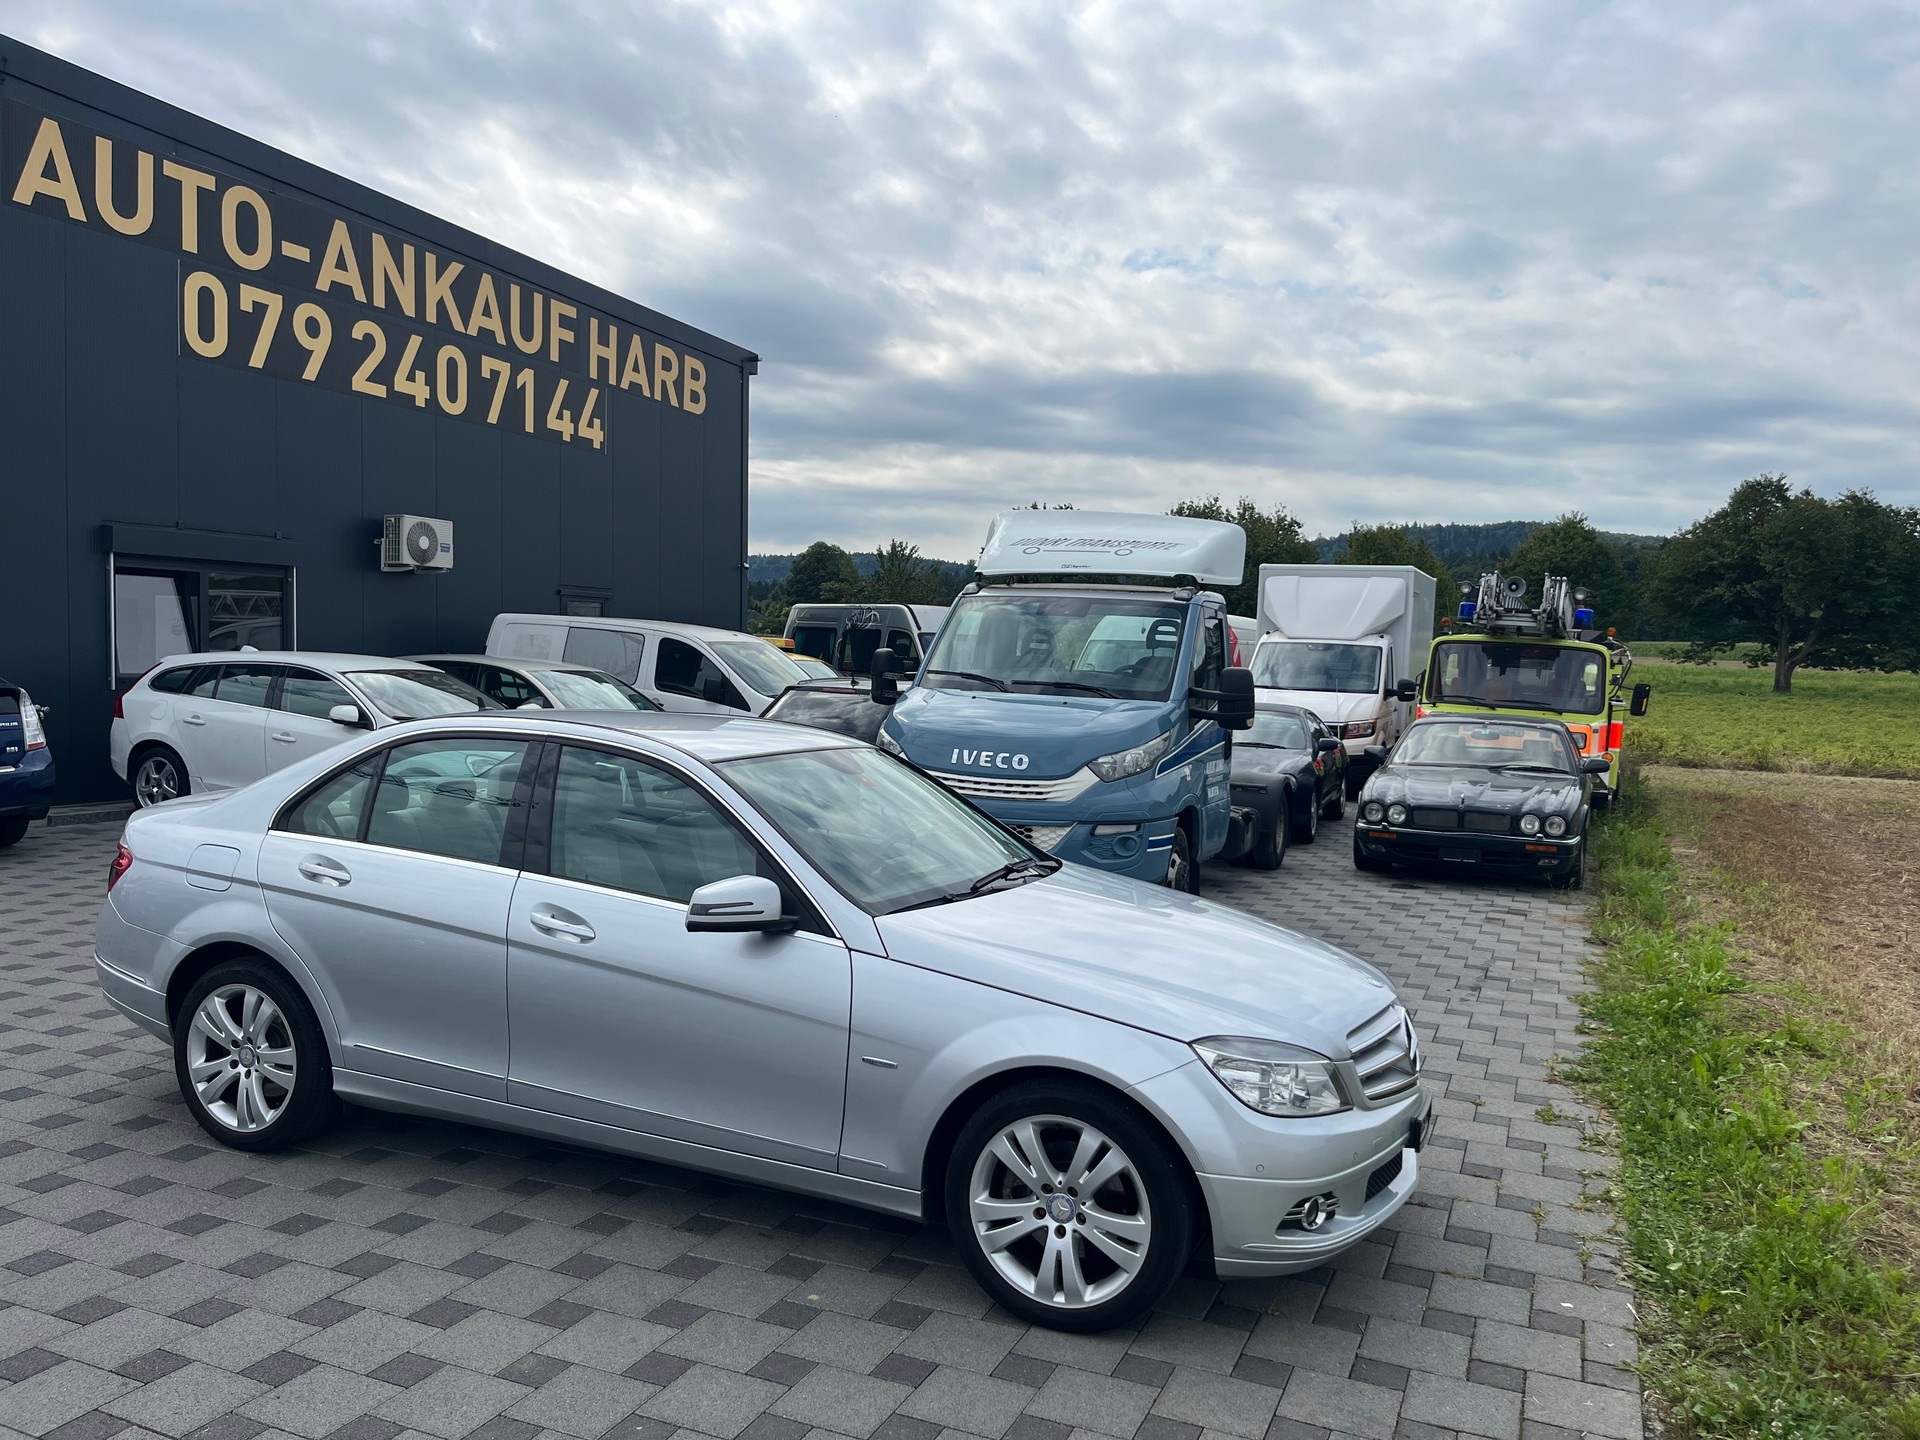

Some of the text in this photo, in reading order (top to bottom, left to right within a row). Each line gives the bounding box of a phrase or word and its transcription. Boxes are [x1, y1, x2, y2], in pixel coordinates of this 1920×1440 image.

[13, 117, 707, 415] AUTO-ANKAUF HARB
[184, 271, 333, 381] 079
[351, 319, 468, 416] 240
[950, 748, 1029, 770] IVECO
